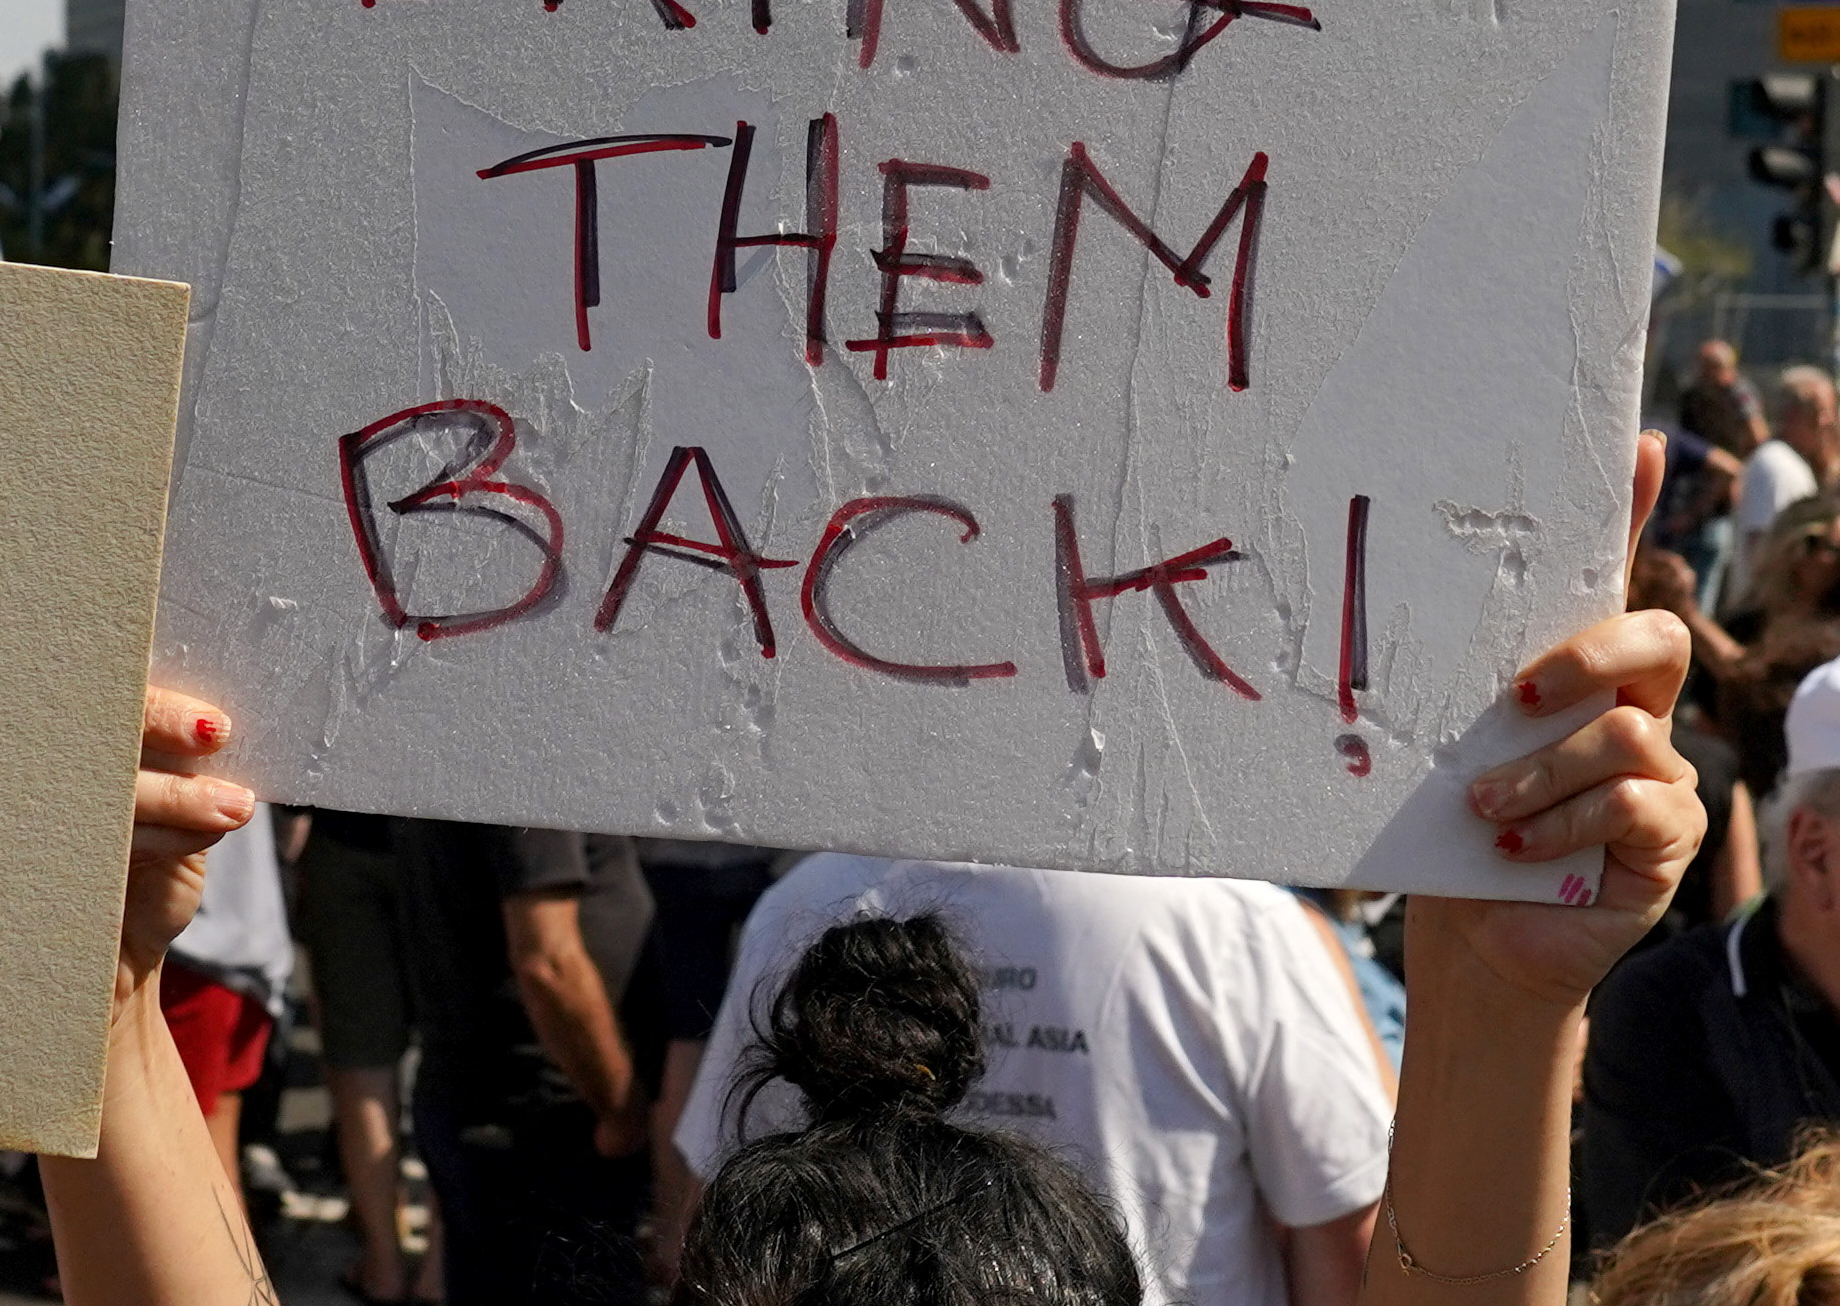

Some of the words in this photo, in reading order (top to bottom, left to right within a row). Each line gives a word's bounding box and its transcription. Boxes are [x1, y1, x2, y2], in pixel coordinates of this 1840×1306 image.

[479, 113, 1269, 392] THEM
[338, 399, 1373, 778] BACK!
[1026, 1025, 1090, 1055] ASIA
